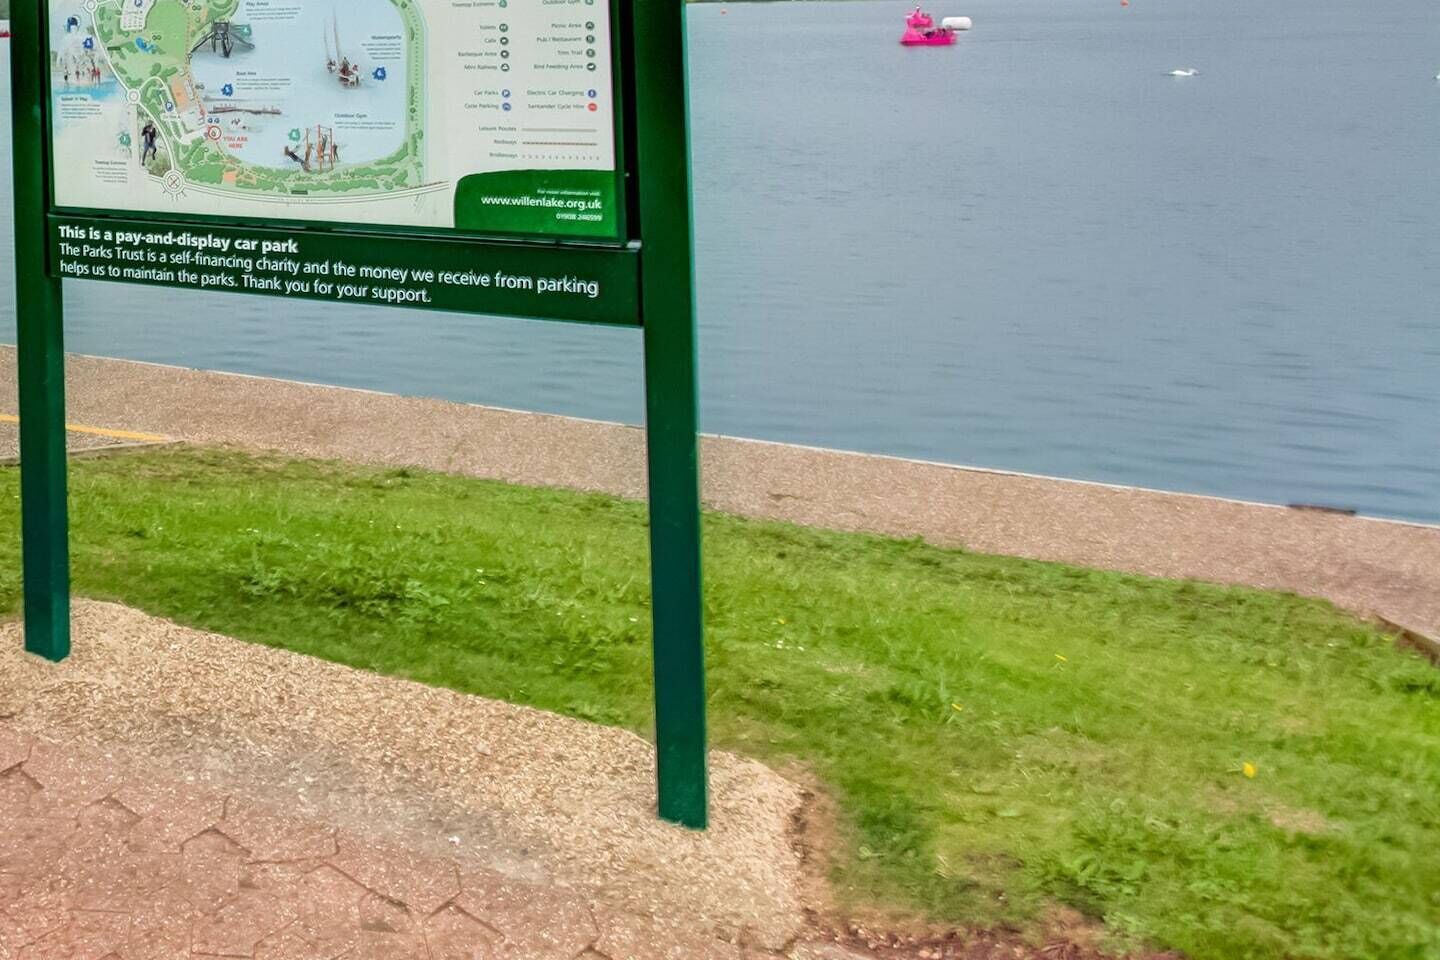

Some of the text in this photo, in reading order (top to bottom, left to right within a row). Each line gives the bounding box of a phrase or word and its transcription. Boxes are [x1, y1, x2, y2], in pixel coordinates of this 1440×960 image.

[481, 196, 602, 211] www.willenlake.org.uk
[58, 226, 299, 256] This is a pay-and-display car park
[60, 243, 600, 298] The Parks Trust is a self-financing charity and the money we receive from parking
[60, 259, 433, 303] helps us to maintain the parks. Thank you for your support.
